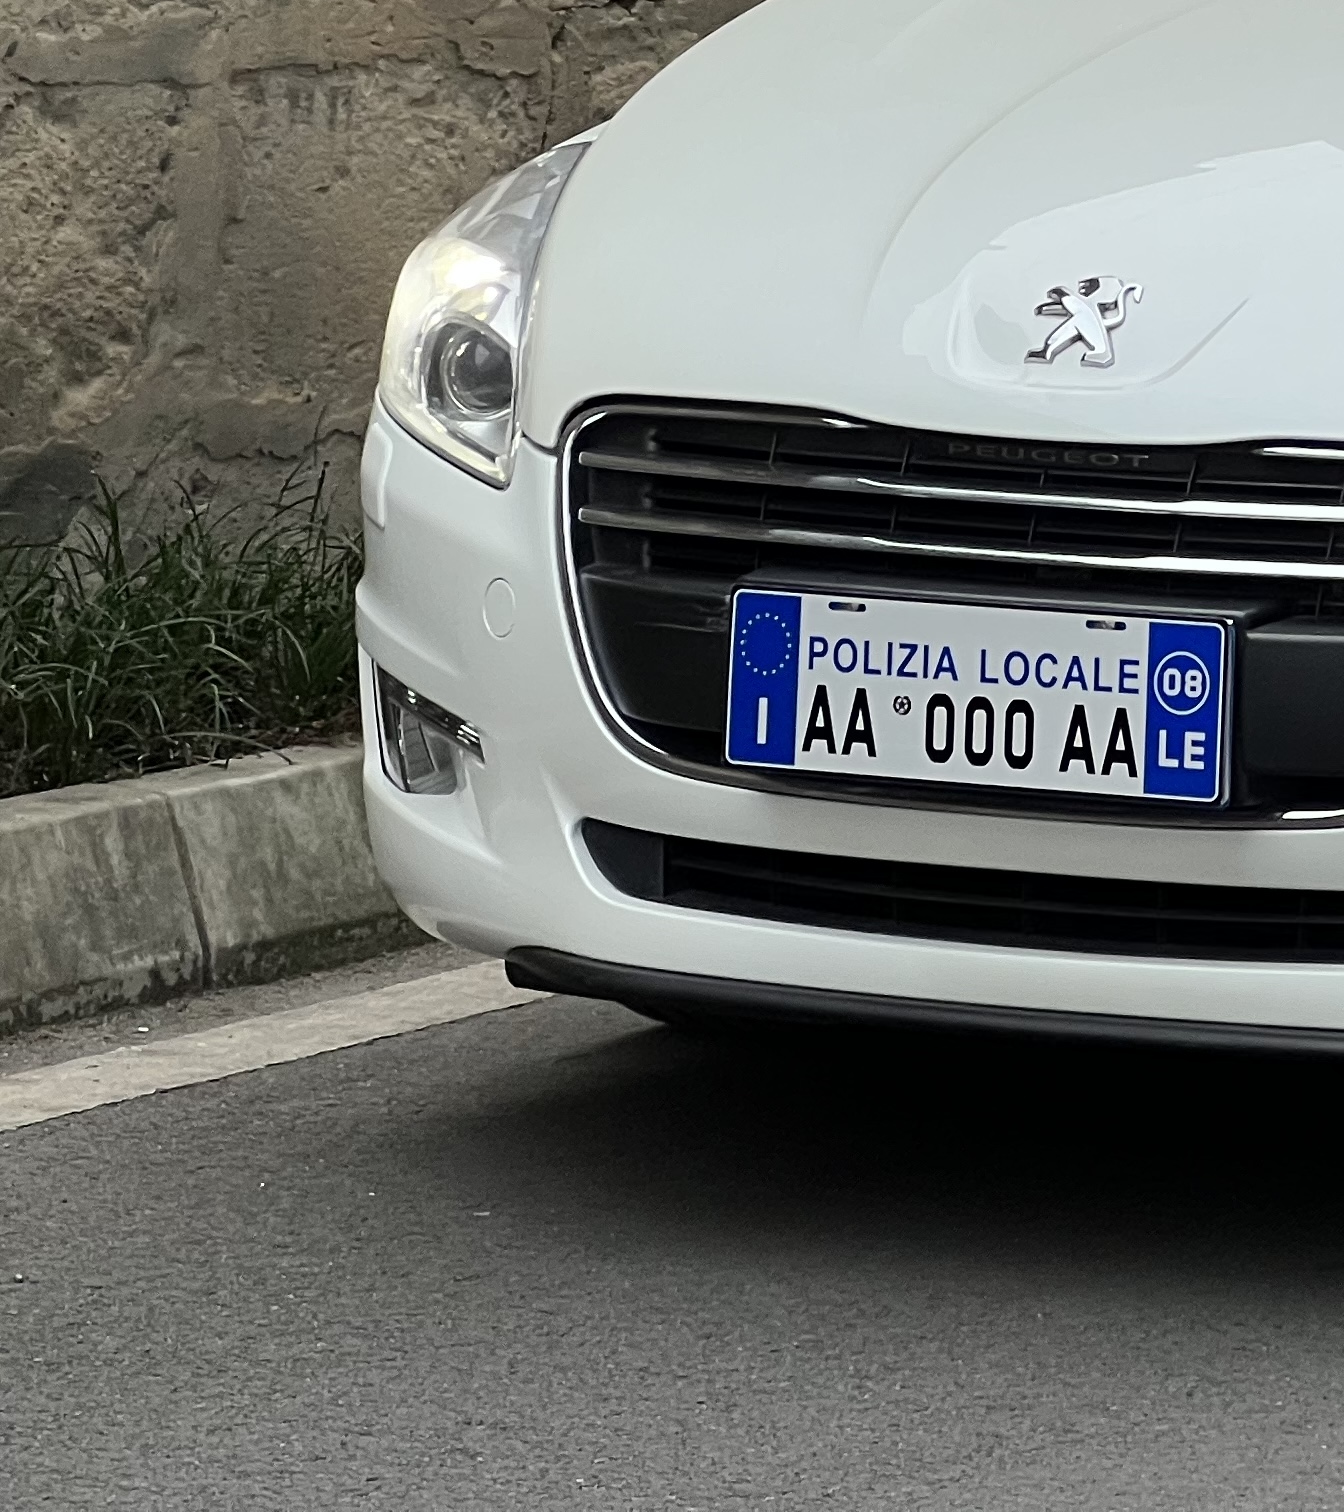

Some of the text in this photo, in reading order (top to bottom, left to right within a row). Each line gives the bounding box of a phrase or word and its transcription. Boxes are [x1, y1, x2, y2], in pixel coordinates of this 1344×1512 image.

[948, 442, 1149, 468] PEUGEOT
[808, 635, 1140, 695] POLIZIA LOCALE
[1162, 667, 1203, 698] 08
[756, 697, 768, 745] I
[801, 684, 1138, 779] AA 000 AA
[1158, 729, 1206, 770] LE
